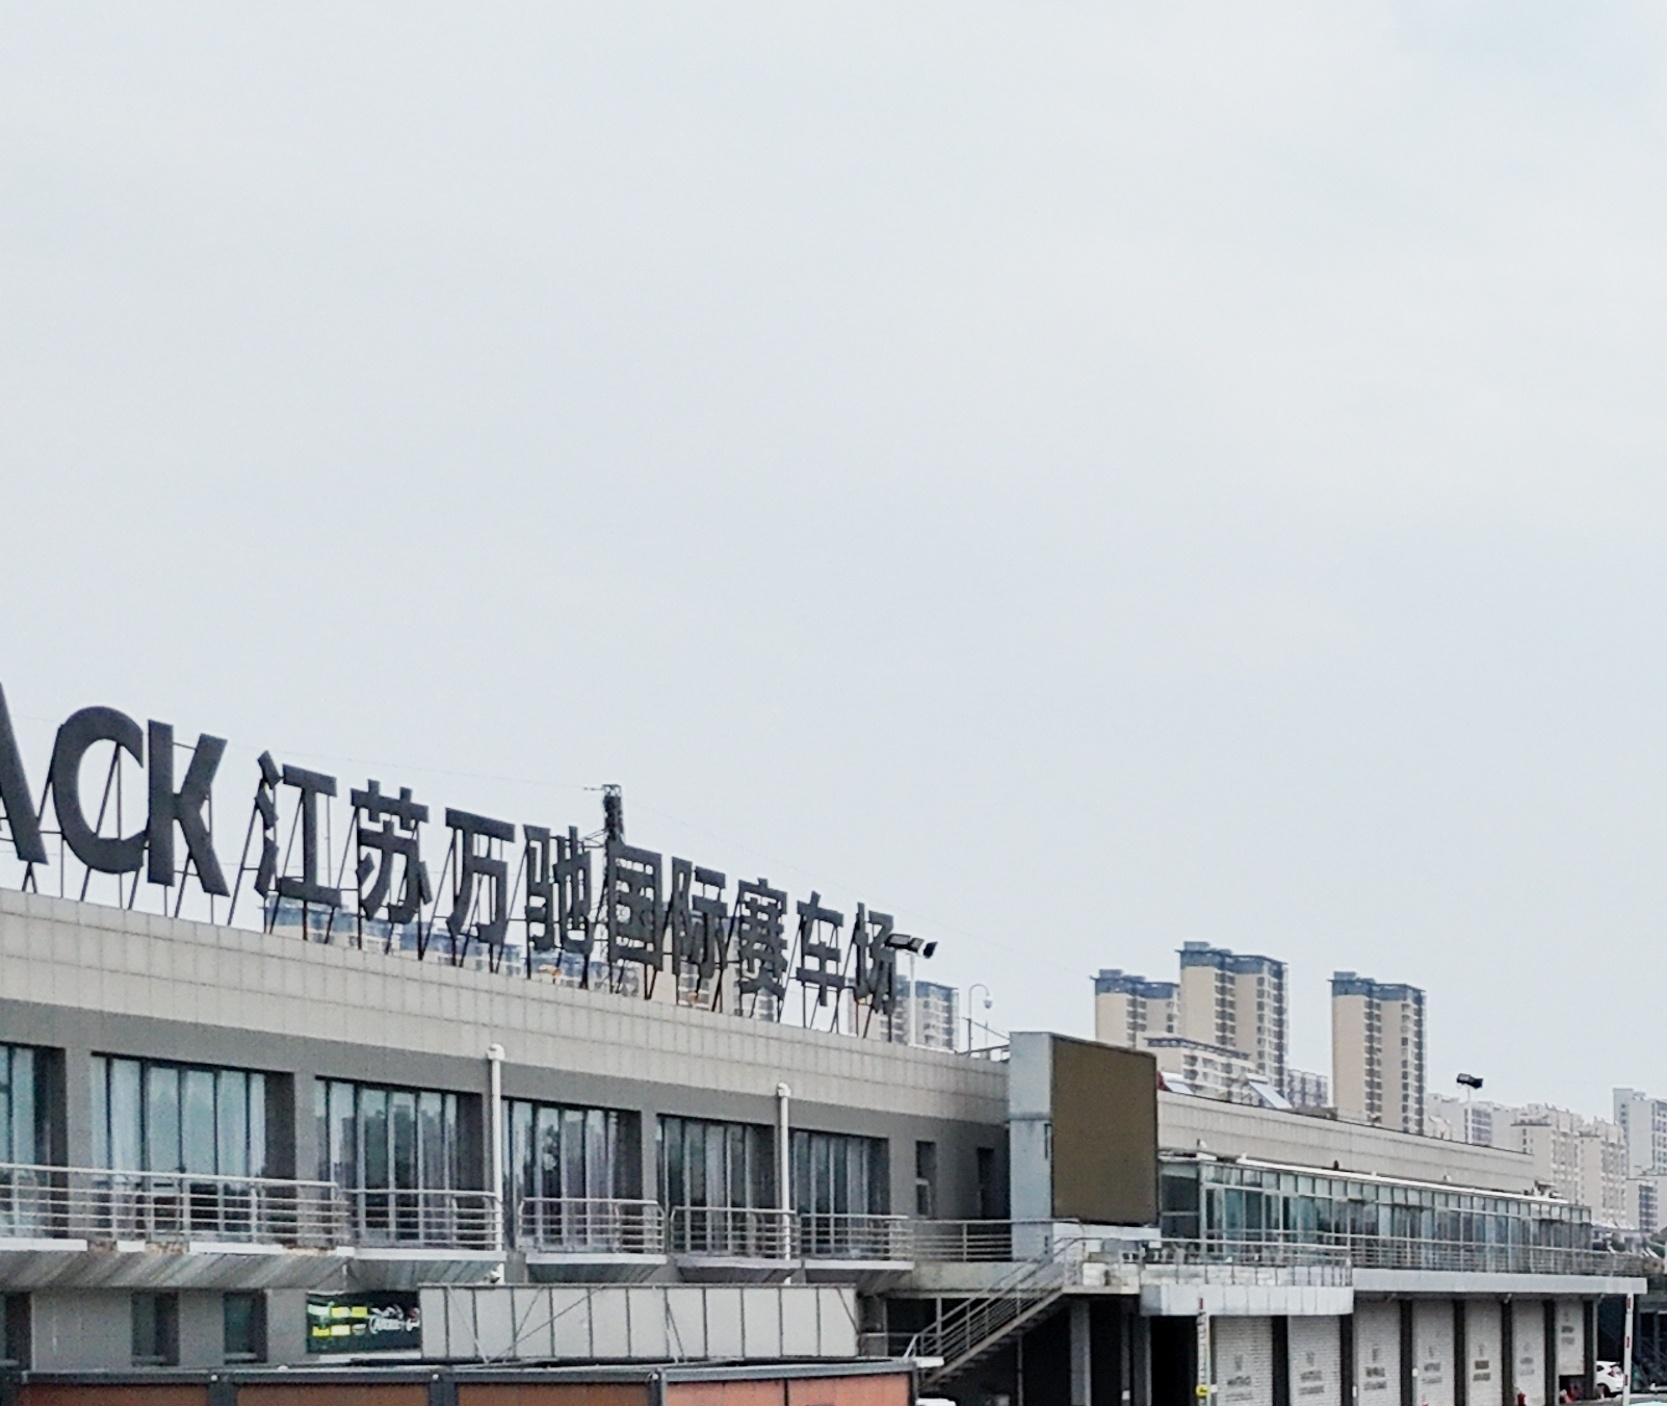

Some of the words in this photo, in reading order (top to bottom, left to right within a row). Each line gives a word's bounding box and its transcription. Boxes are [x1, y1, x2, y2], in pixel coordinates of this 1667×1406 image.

[255, 749, 897, 1015] 江苏万驰国际赛车场
